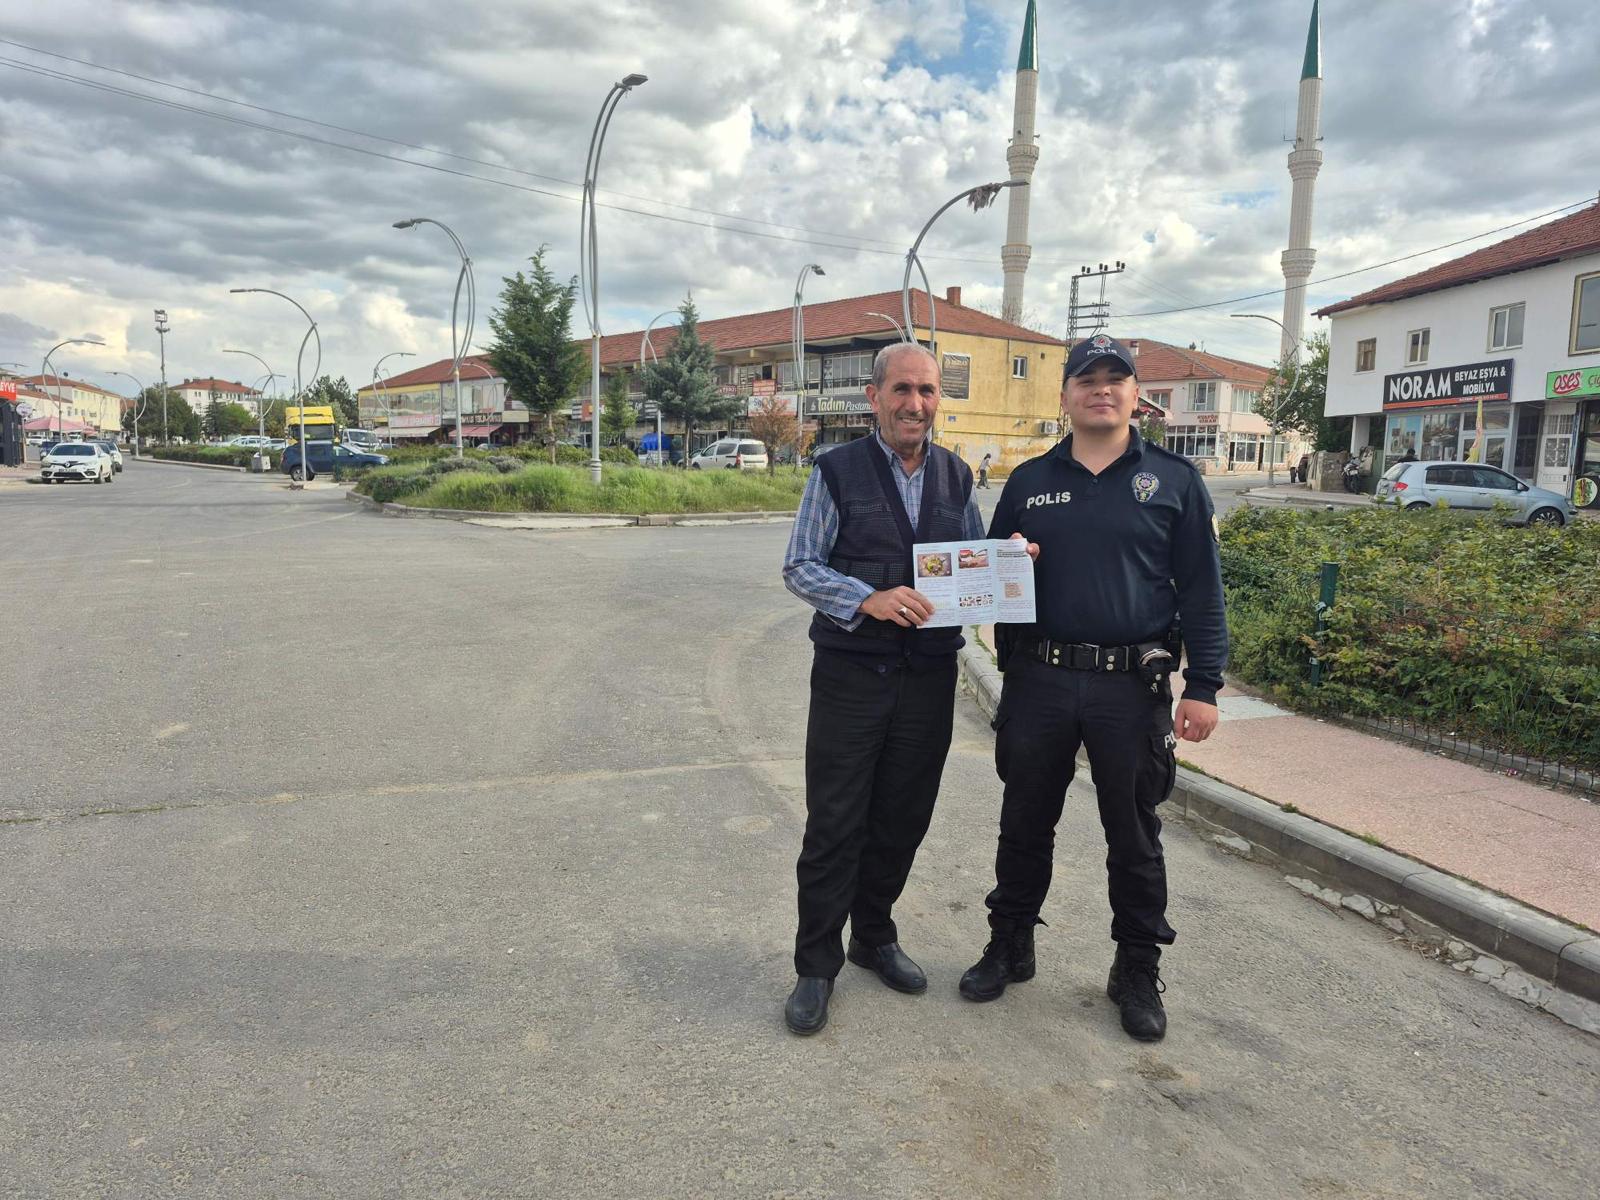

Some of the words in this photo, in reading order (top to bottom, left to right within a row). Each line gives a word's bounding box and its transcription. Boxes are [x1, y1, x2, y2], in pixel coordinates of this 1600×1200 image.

[1455, 369, 1477, 382] BEYAZ
[1480, 367, 1498, 380] EŞYA
[1500, 366, 1506, 377] &
[1389, 372, 1451, 401] NORAM
[1463, 382, 1495, 395] MOBİLYA
[817, 397, 845, 412] Tadım
